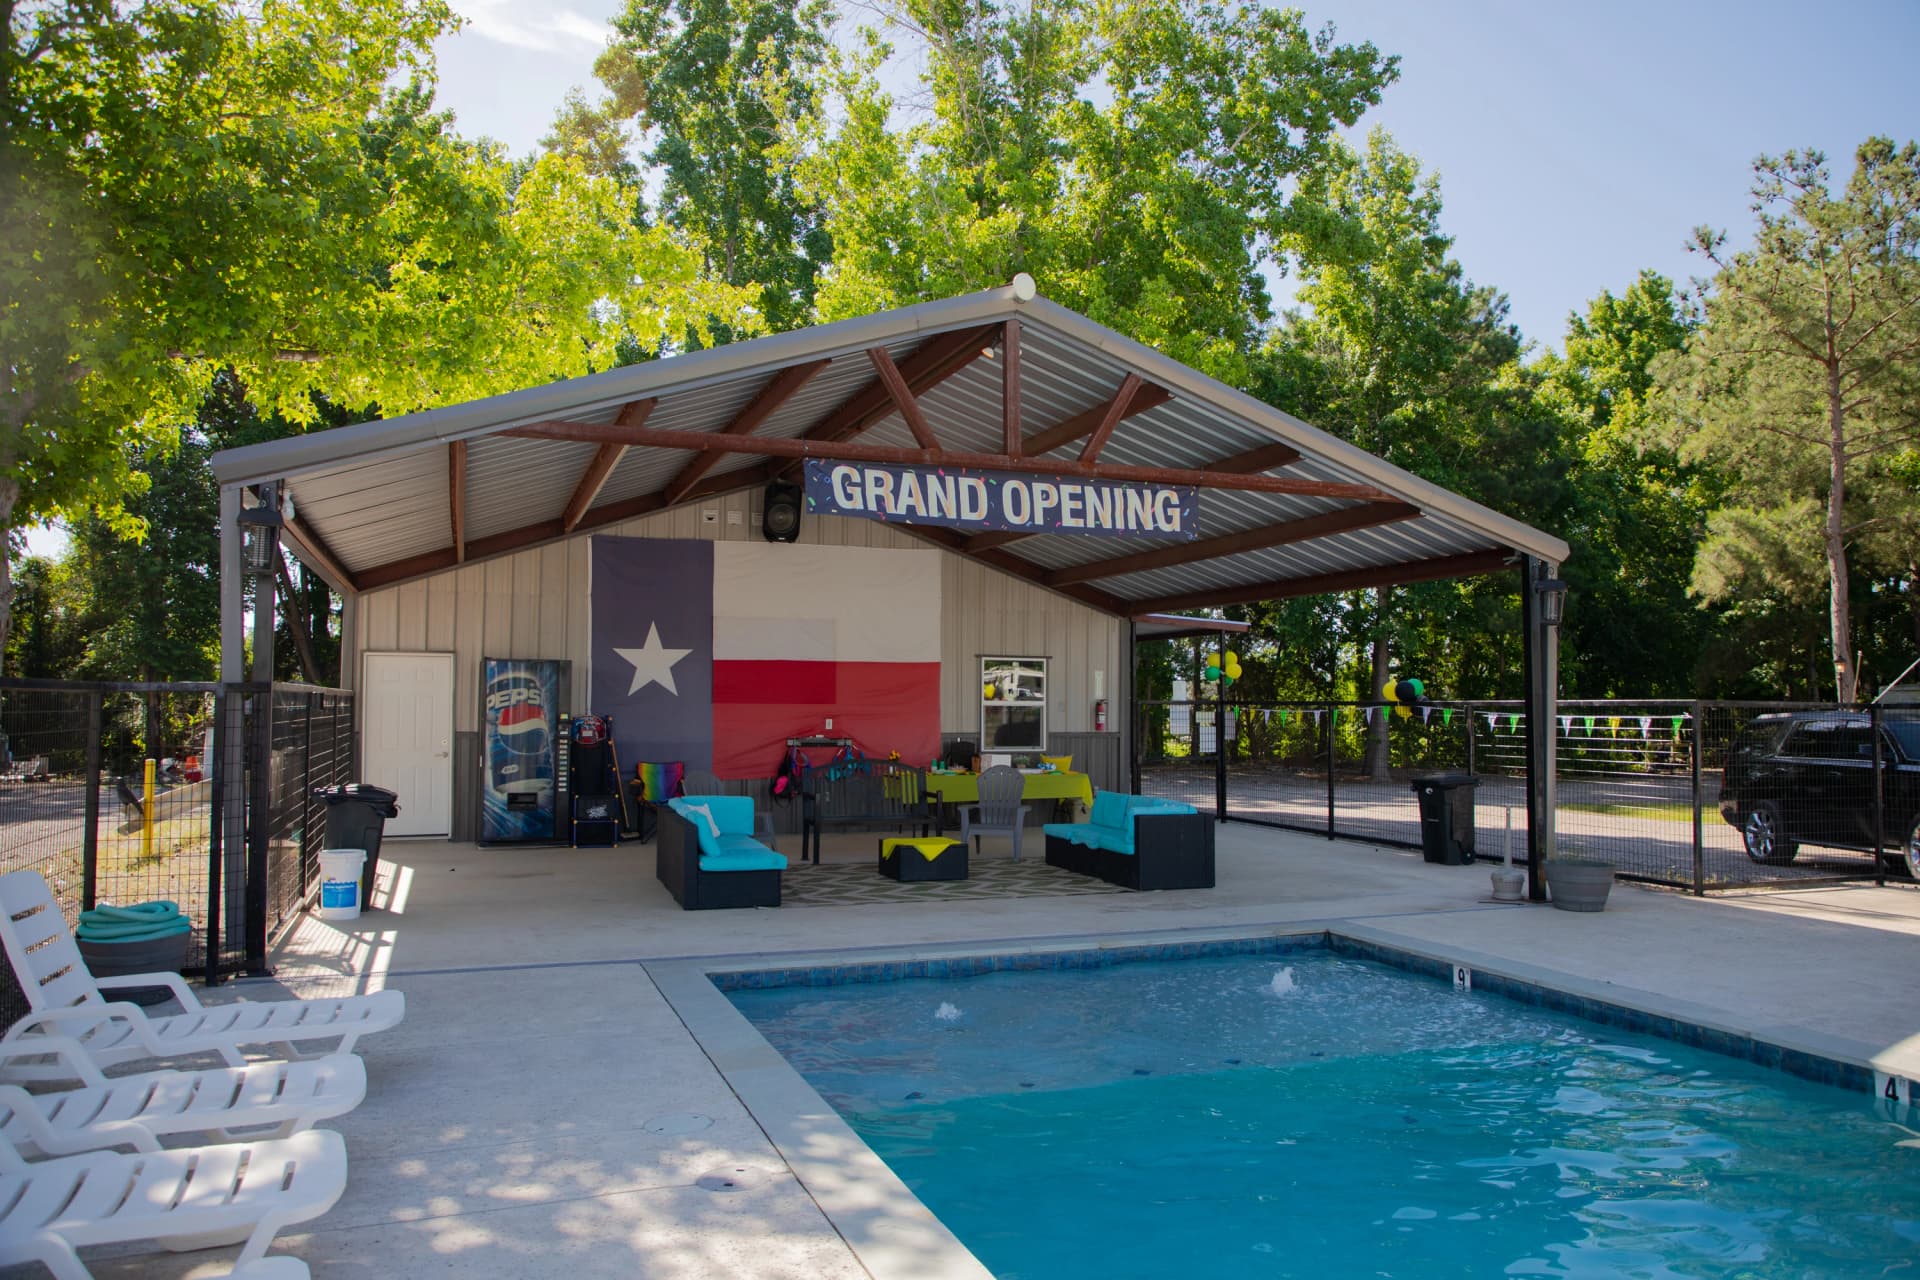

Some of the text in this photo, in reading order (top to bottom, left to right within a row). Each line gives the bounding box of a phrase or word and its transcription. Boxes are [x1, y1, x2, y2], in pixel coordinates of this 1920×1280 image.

[831, 465, 1181, 532] GRAND OPENING
[1884, 1075, 1899, 1102] 4
